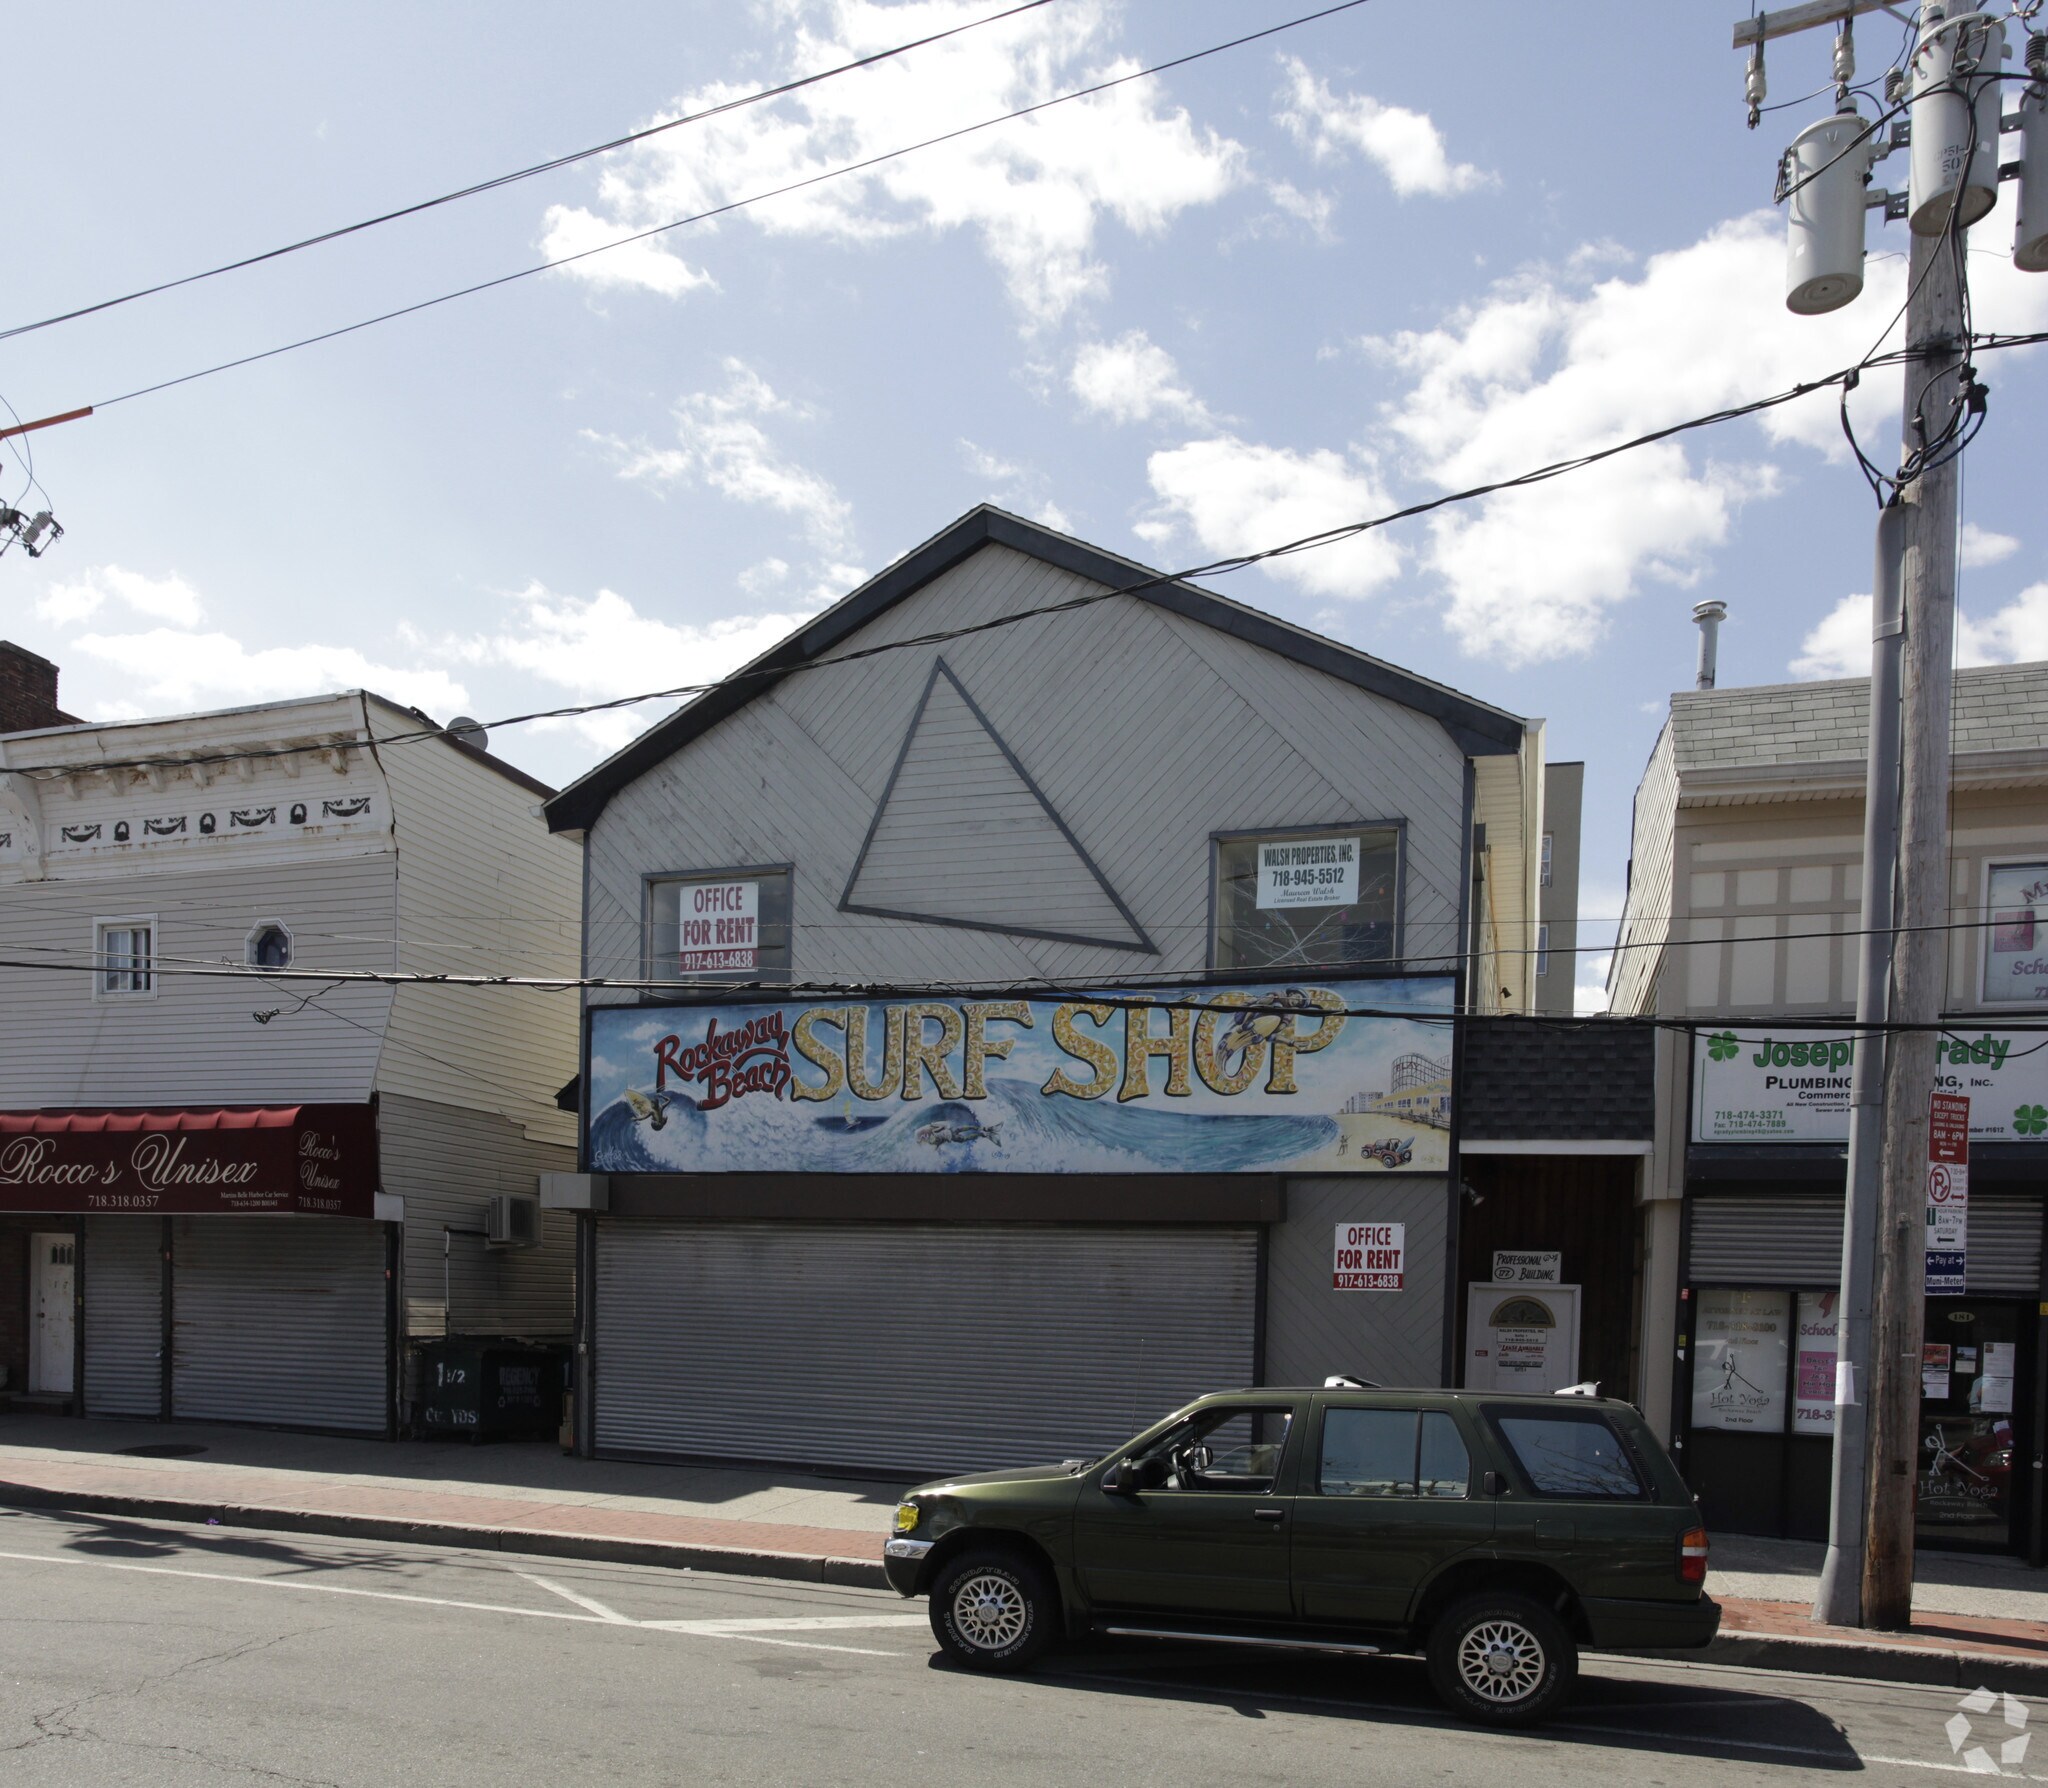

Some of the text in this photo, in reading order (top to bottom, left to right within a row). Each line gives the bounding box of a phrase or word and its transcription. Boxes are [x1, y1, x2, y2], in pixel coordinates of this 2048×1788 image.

[1264, 844, 1354, 866] WALSH PROPERTIES, INC.
[1273, 867, 1344, 886] 718-945-5512
[694, 886, 742, 912] OFFICE
[1280, 887, 1335, 896] Maureen Walsh
[684, 917, 754, 946] FOR RENT
[685, 951, 753, 969] 917-613-6838
[654, 1009, 791, 1093] Rockaway
[790, 987, 1346, 1102] SURF SHOP
[1753, 1034, 2010, 1073] Josep rady
[697, 1058, 792, 1111] Beach
[1970, 1078, 1994, 1086] INC.
[1715, 1111, 1783, 1119] 718-474-3371
[1933, 1100, 1967, 1112] NO STANDING
[1729, 1120, 1786, 1128] 718-474-7889
[1934, 1130, 1946, 1139] 8AM
[1952, 1132, 1964, 1141] 6PM
[298, 1130, 341, 1160] Rocco's
[132, 1134, 258, 1192] Unisex
[300, 1160, 340, 1190] Unisex
[88, 1196, 159, 1207] 718.318.0357
[298, 1196, 341, 1210] 718.318.0357
[1348, 1227, 1391, 1246] OFFICE
[1337, 1250, 1400, 1269] FOR RENT
[1497, 1254, 1542, 1266] PROFESSIONAL
[1935, 1256, 1955, 1266] Pay at
[1338, 1274, 1399, 1288] 917-613-6838
[1518, 1268, 1555, 1280] BUILDING
[1926, 1277, 1963, 1285] Muni-Meter
[1800, 1323, 1838, 1336] School
[436, 1362, 444, 1387] 1
[1710, 1392, 1770, 1407] Hot Yoga
[1918, 1480, 1998, 1500] Hot Yoga
